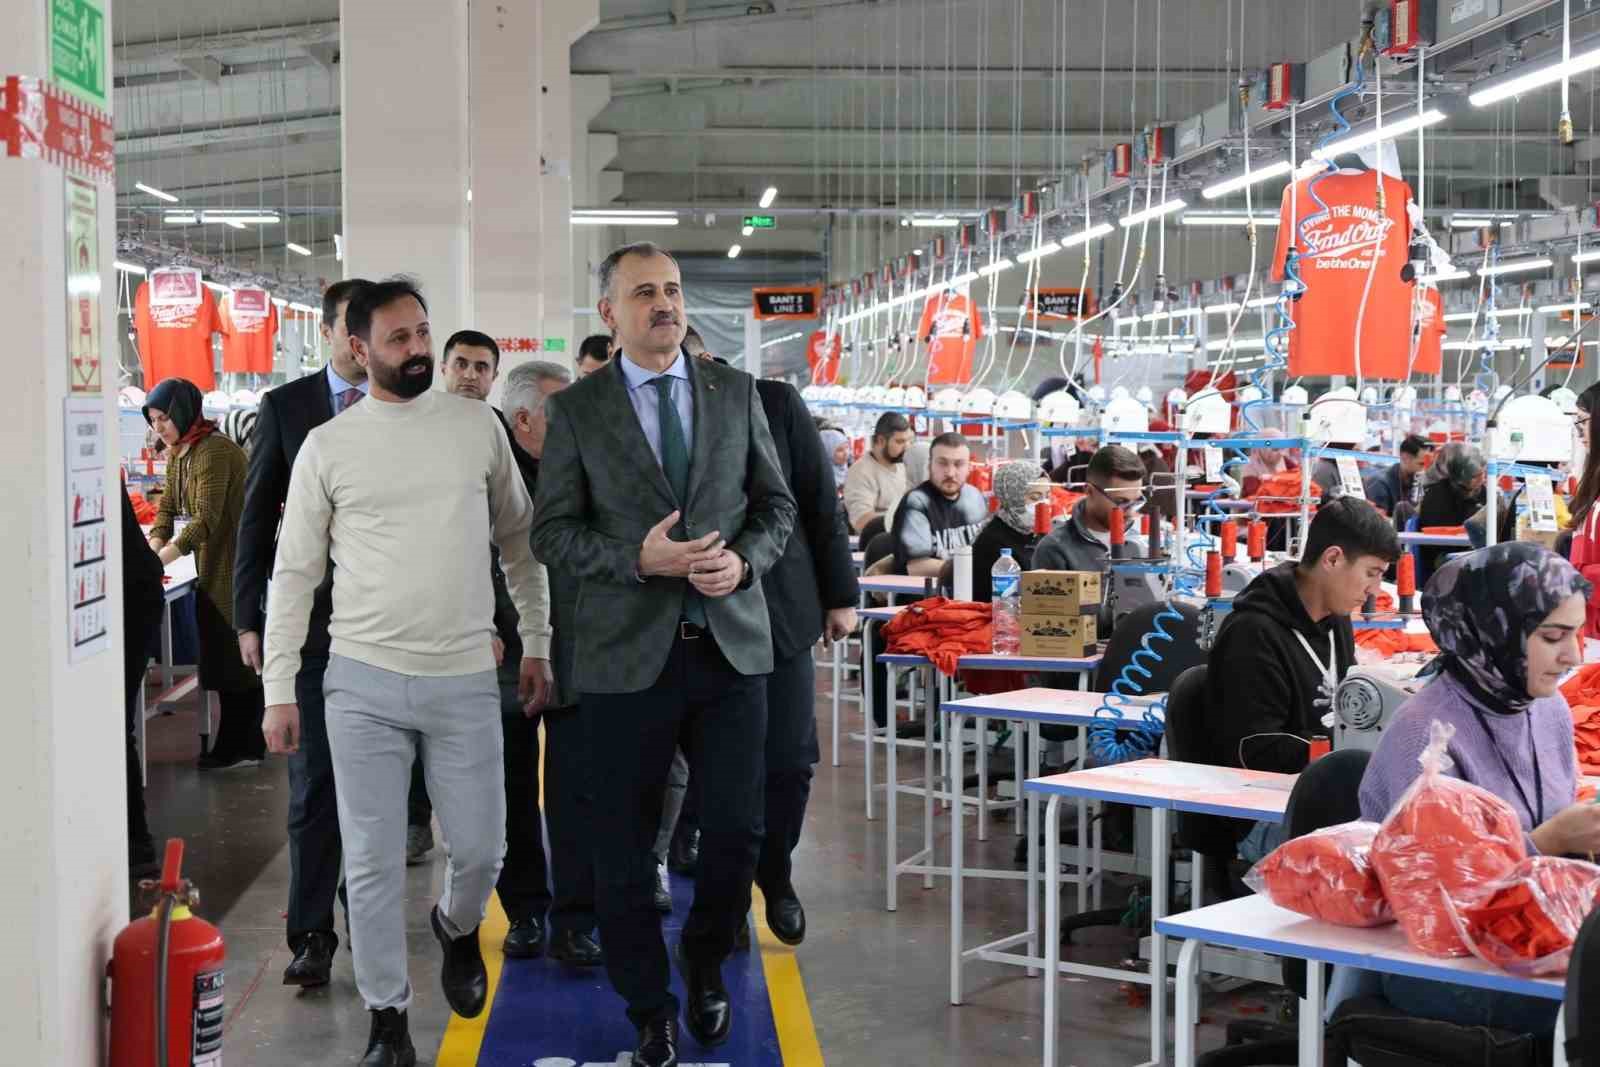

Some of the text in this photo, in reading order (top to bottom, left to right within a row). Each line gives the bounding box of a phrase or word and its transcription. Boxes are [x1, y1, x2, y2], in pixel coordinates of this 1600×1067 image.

[1331, 205, 1353, 218] THE
[769, 295, 794, 304] BANT
[1044, 296, 1070, 305] BANT
[774, 305, 794, 313] LINE
